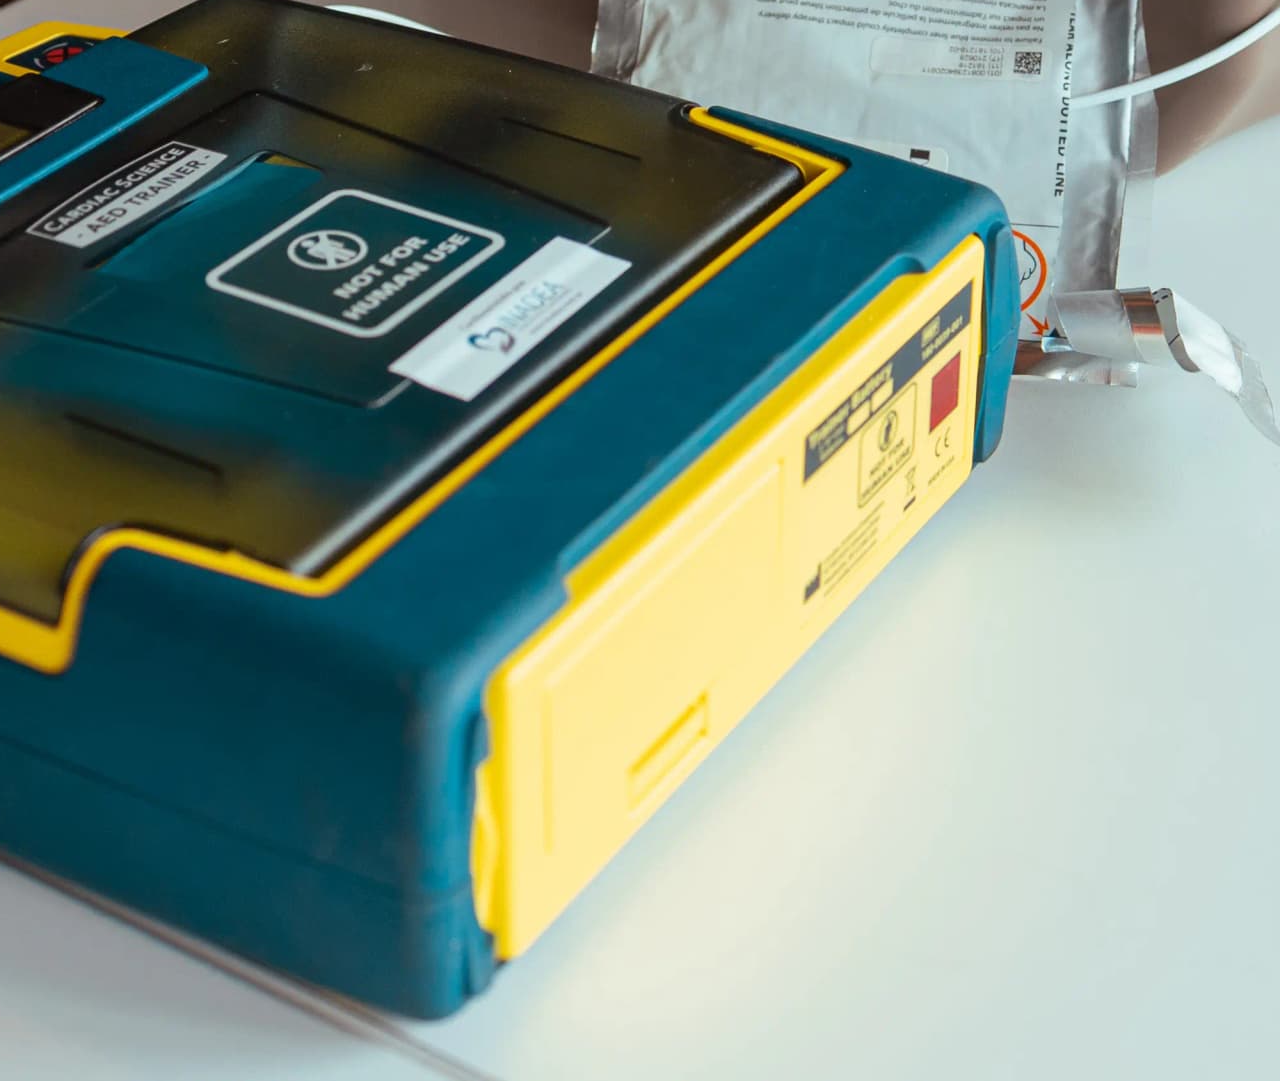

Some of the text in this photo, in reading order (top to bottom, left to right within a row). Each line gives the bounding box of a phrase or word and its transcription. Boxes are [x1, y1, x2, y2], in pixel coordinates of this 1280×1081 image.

[44, 147, 186, 234] CARDIAC SCIENCE
[87, 206, 128, 234] AED
[123, 159, 207, 207] TRAINER
[1054, 163, 1065, 198] LINE
[333, 235, 429, 299] NOT FOR
[342, 261, 430, 321] HUMAN
[422, 232, 472, 262] USE
